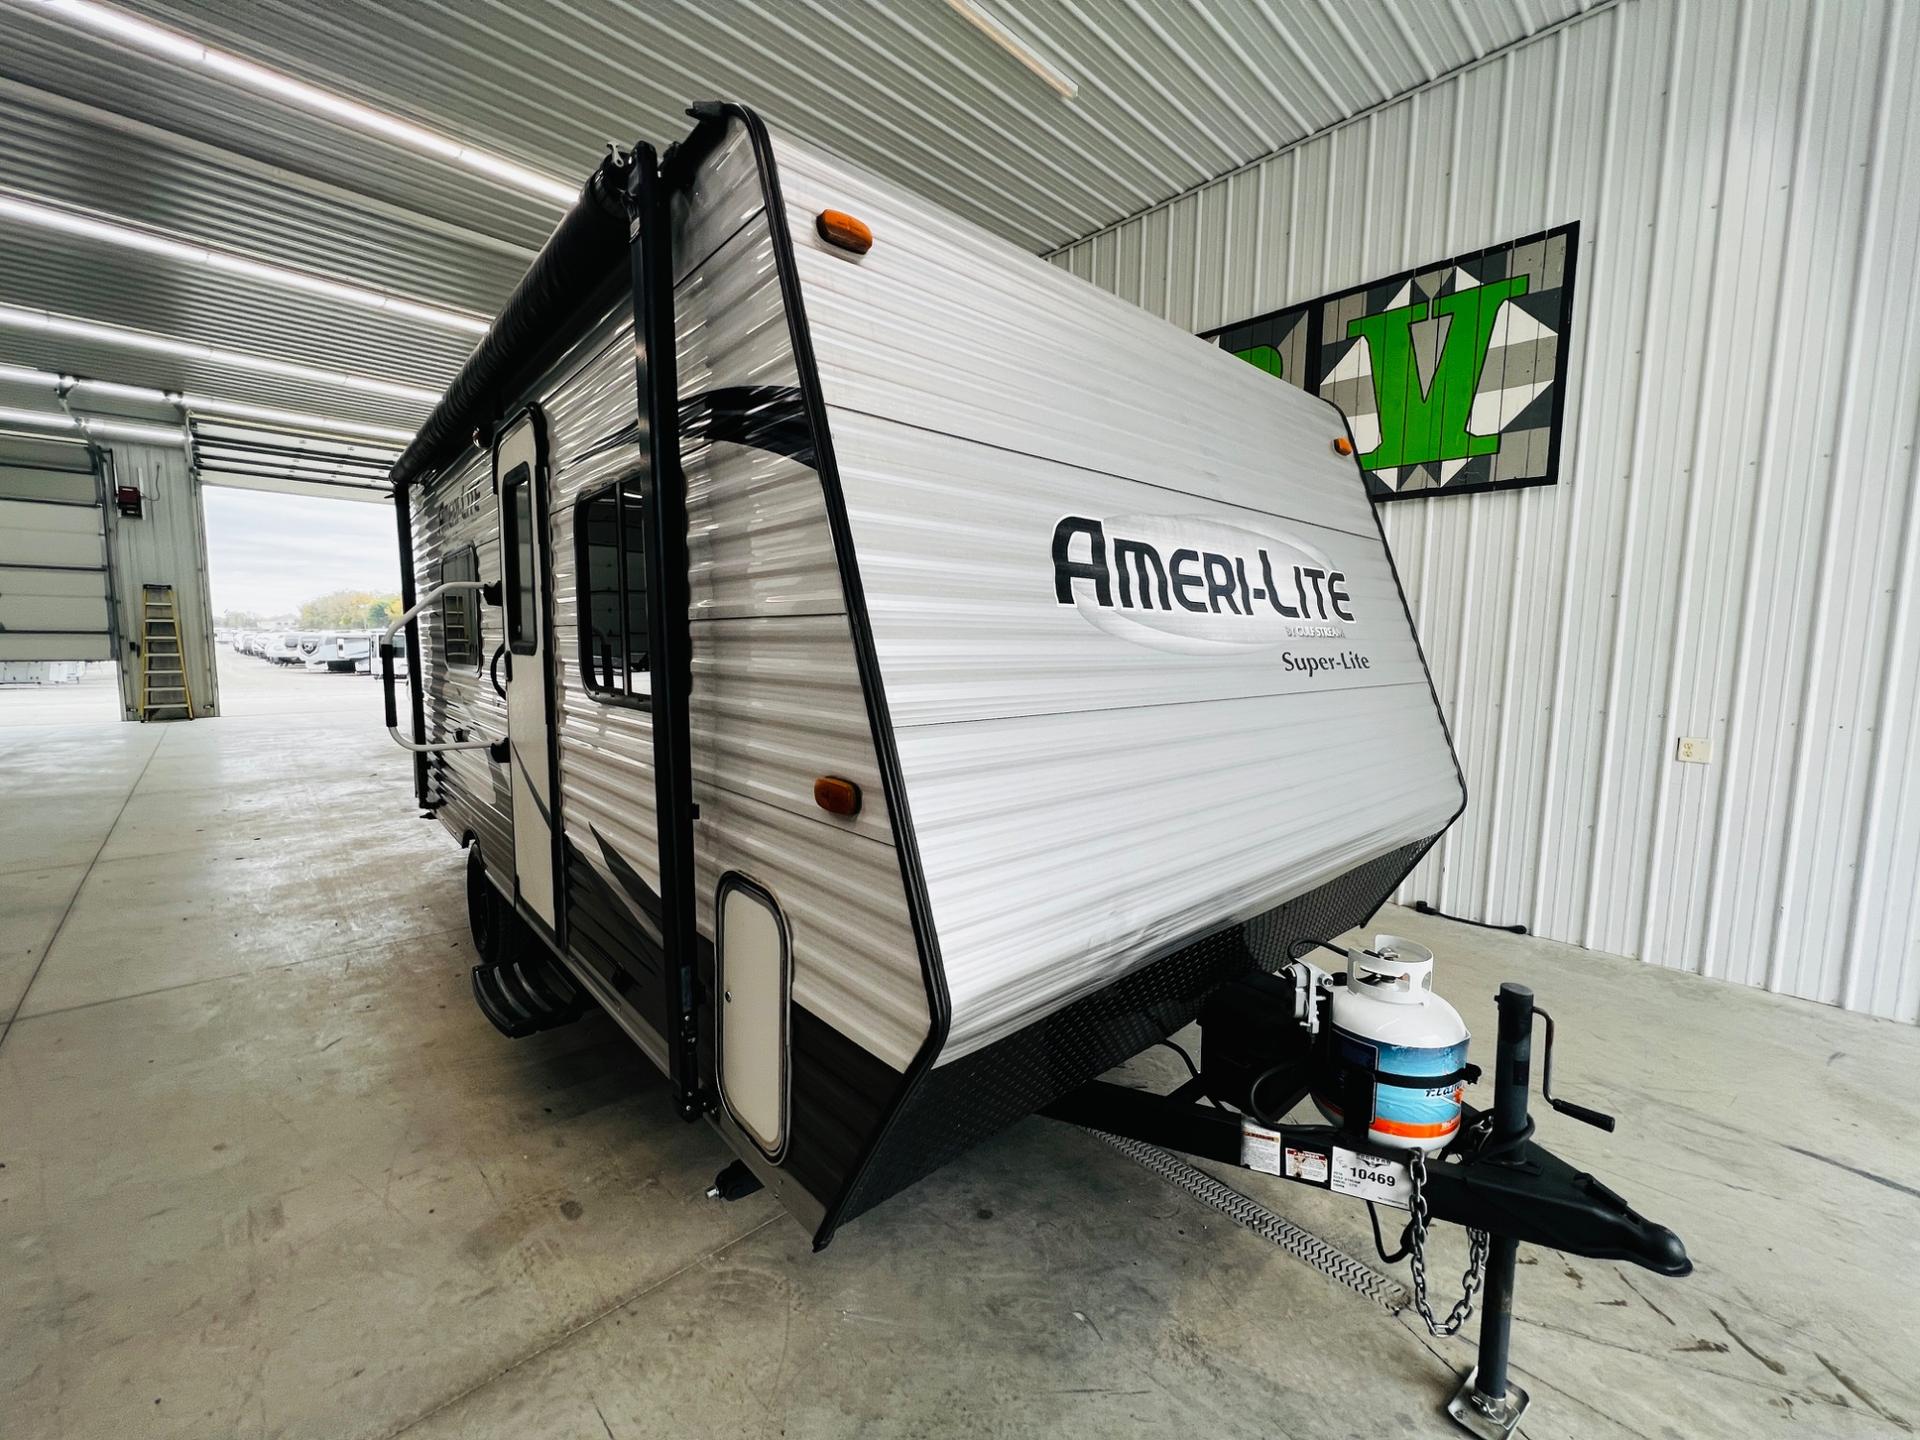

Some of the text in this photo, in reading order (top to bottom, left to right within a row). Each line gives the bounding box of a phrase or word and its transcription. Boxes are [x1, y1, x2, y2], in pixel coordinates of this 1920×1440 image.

[1051, 515, 1356, 622] AMERI-LITE
[1282, 651, 1371, 677] Super-Lite
[1350, 1167, 1396, 1187] 10469
